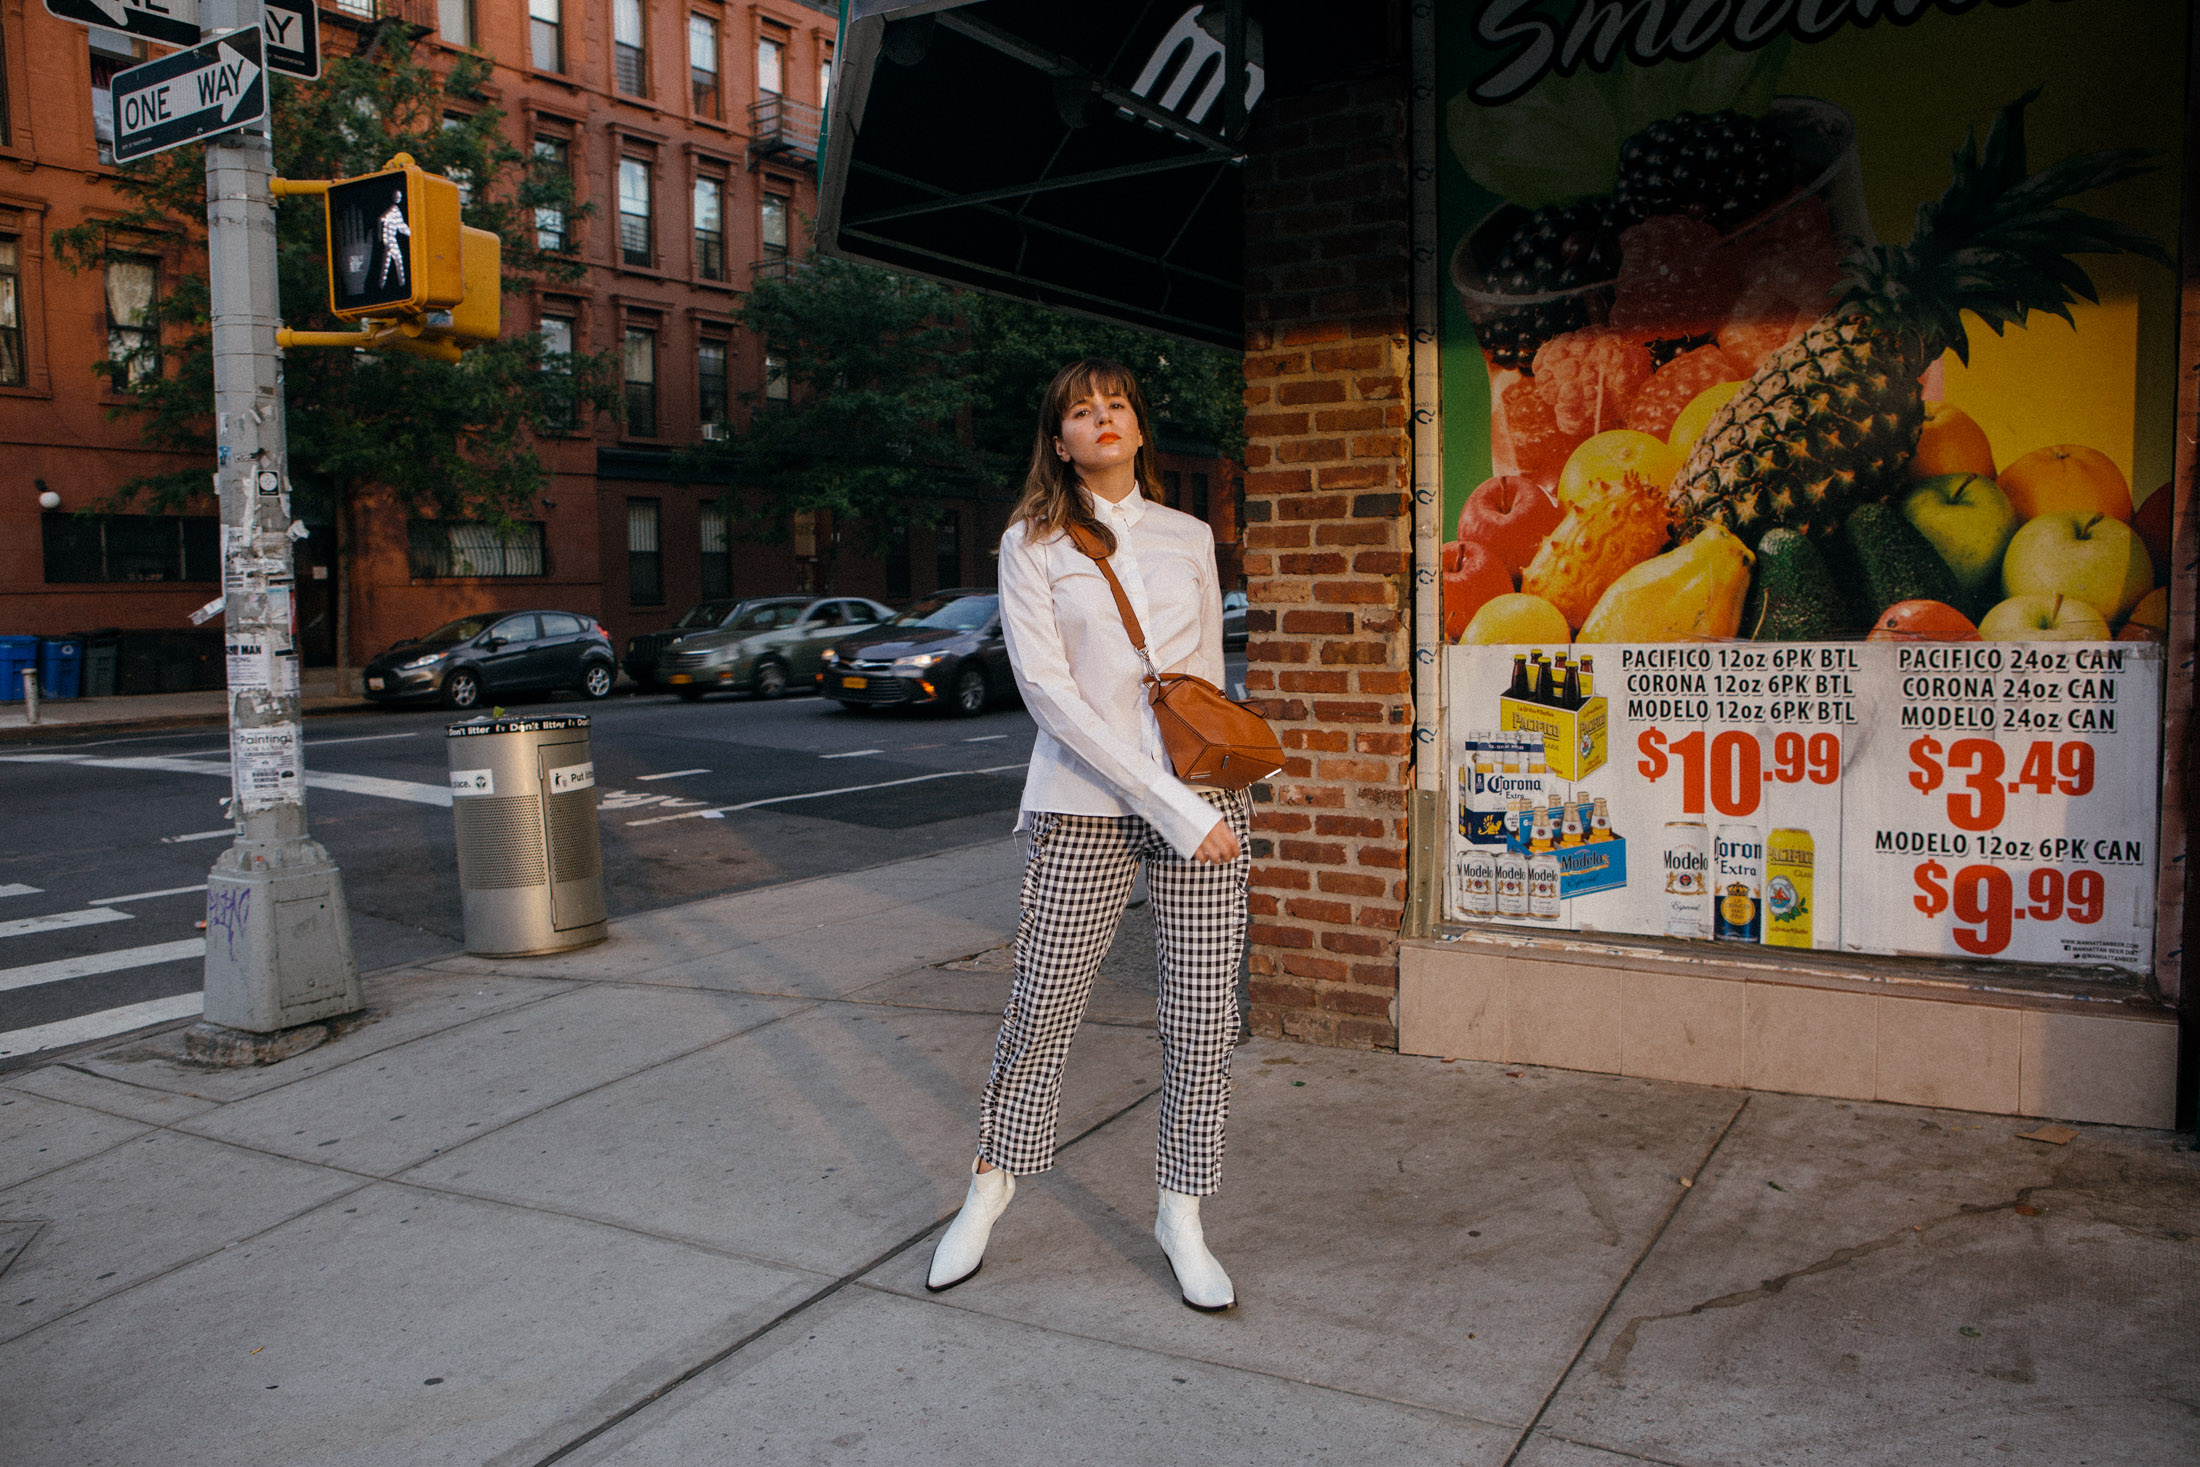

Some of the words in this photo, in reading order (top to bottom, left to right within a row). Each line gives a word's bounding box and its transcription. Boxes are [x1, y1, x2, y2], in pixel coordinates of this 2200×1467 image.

[125, 85, 172, 130] ONE
[196, 59, 245, 107] WAY
[1622, 649, 1711, 669] PACIFICO
[1718, 649, 1766, 669] 12oz
[1773, 649, 1814, 669] 6PK
[1821, 649, 1859, 669] BTL
[1899, 649, 2002, 670] PACIFICO
[2010, 649, 2068, 670] 24oz
[2076, 650, 2124, 671] CAN
[1627, 674, 1707, 693] CORONA
[1714, 674, 1761, 694] 12oz
[1768, 675, 1808, 694] 6PK
[1816, 675, 1854, 694] BTL
[1902, 677, 1995, 698] CORONA
[2003, 678, 2060, 699] 24oz
[2067, 679, 2116, 701] CAN
[1628, 700, 1709, 719] MODELO
[1716, 701, 1764, 720] 12oz
[1770, 701, 1811, 721] 6PK
[1818, 702, 1856, 721] BTL
[1901, 706, 1995, 727] MODELO
[2003, 707, 2060, 728] 24oz
[2068, 709, 2116, 731] CAN
[467, 726, 490, 735] litter
[509, 721, 539, 733] Don't
[542, 720, 566, 730] litter
[571, 772, 584, 783] Put
[1637, 726, 1840, 817] $10.99
[1487, 775, 1541, 795] Corona
[1908, 734, 2095, 832] $3.49
[1714, 835, 1762, 863] oron
[1875, 830, 1968, 854] MODELO
[1976, 836, 2031, 857] 12oz
[2040, 838, 2088, 860] 6PK
[2094, 840, 2143, 862] CAN
[1464, 863, 1494, 879] Modelo
[1561, 850, 1603, 871] Modelo
[1664, 850, 1709, 871] Modelo
[1721, 860, 1757, 876] Extra
[1495, 865, 1526, 881] Modelo
[1528, 867, 1558, 882] Modelo
[1913, 859, 2105, 955] $9.99
